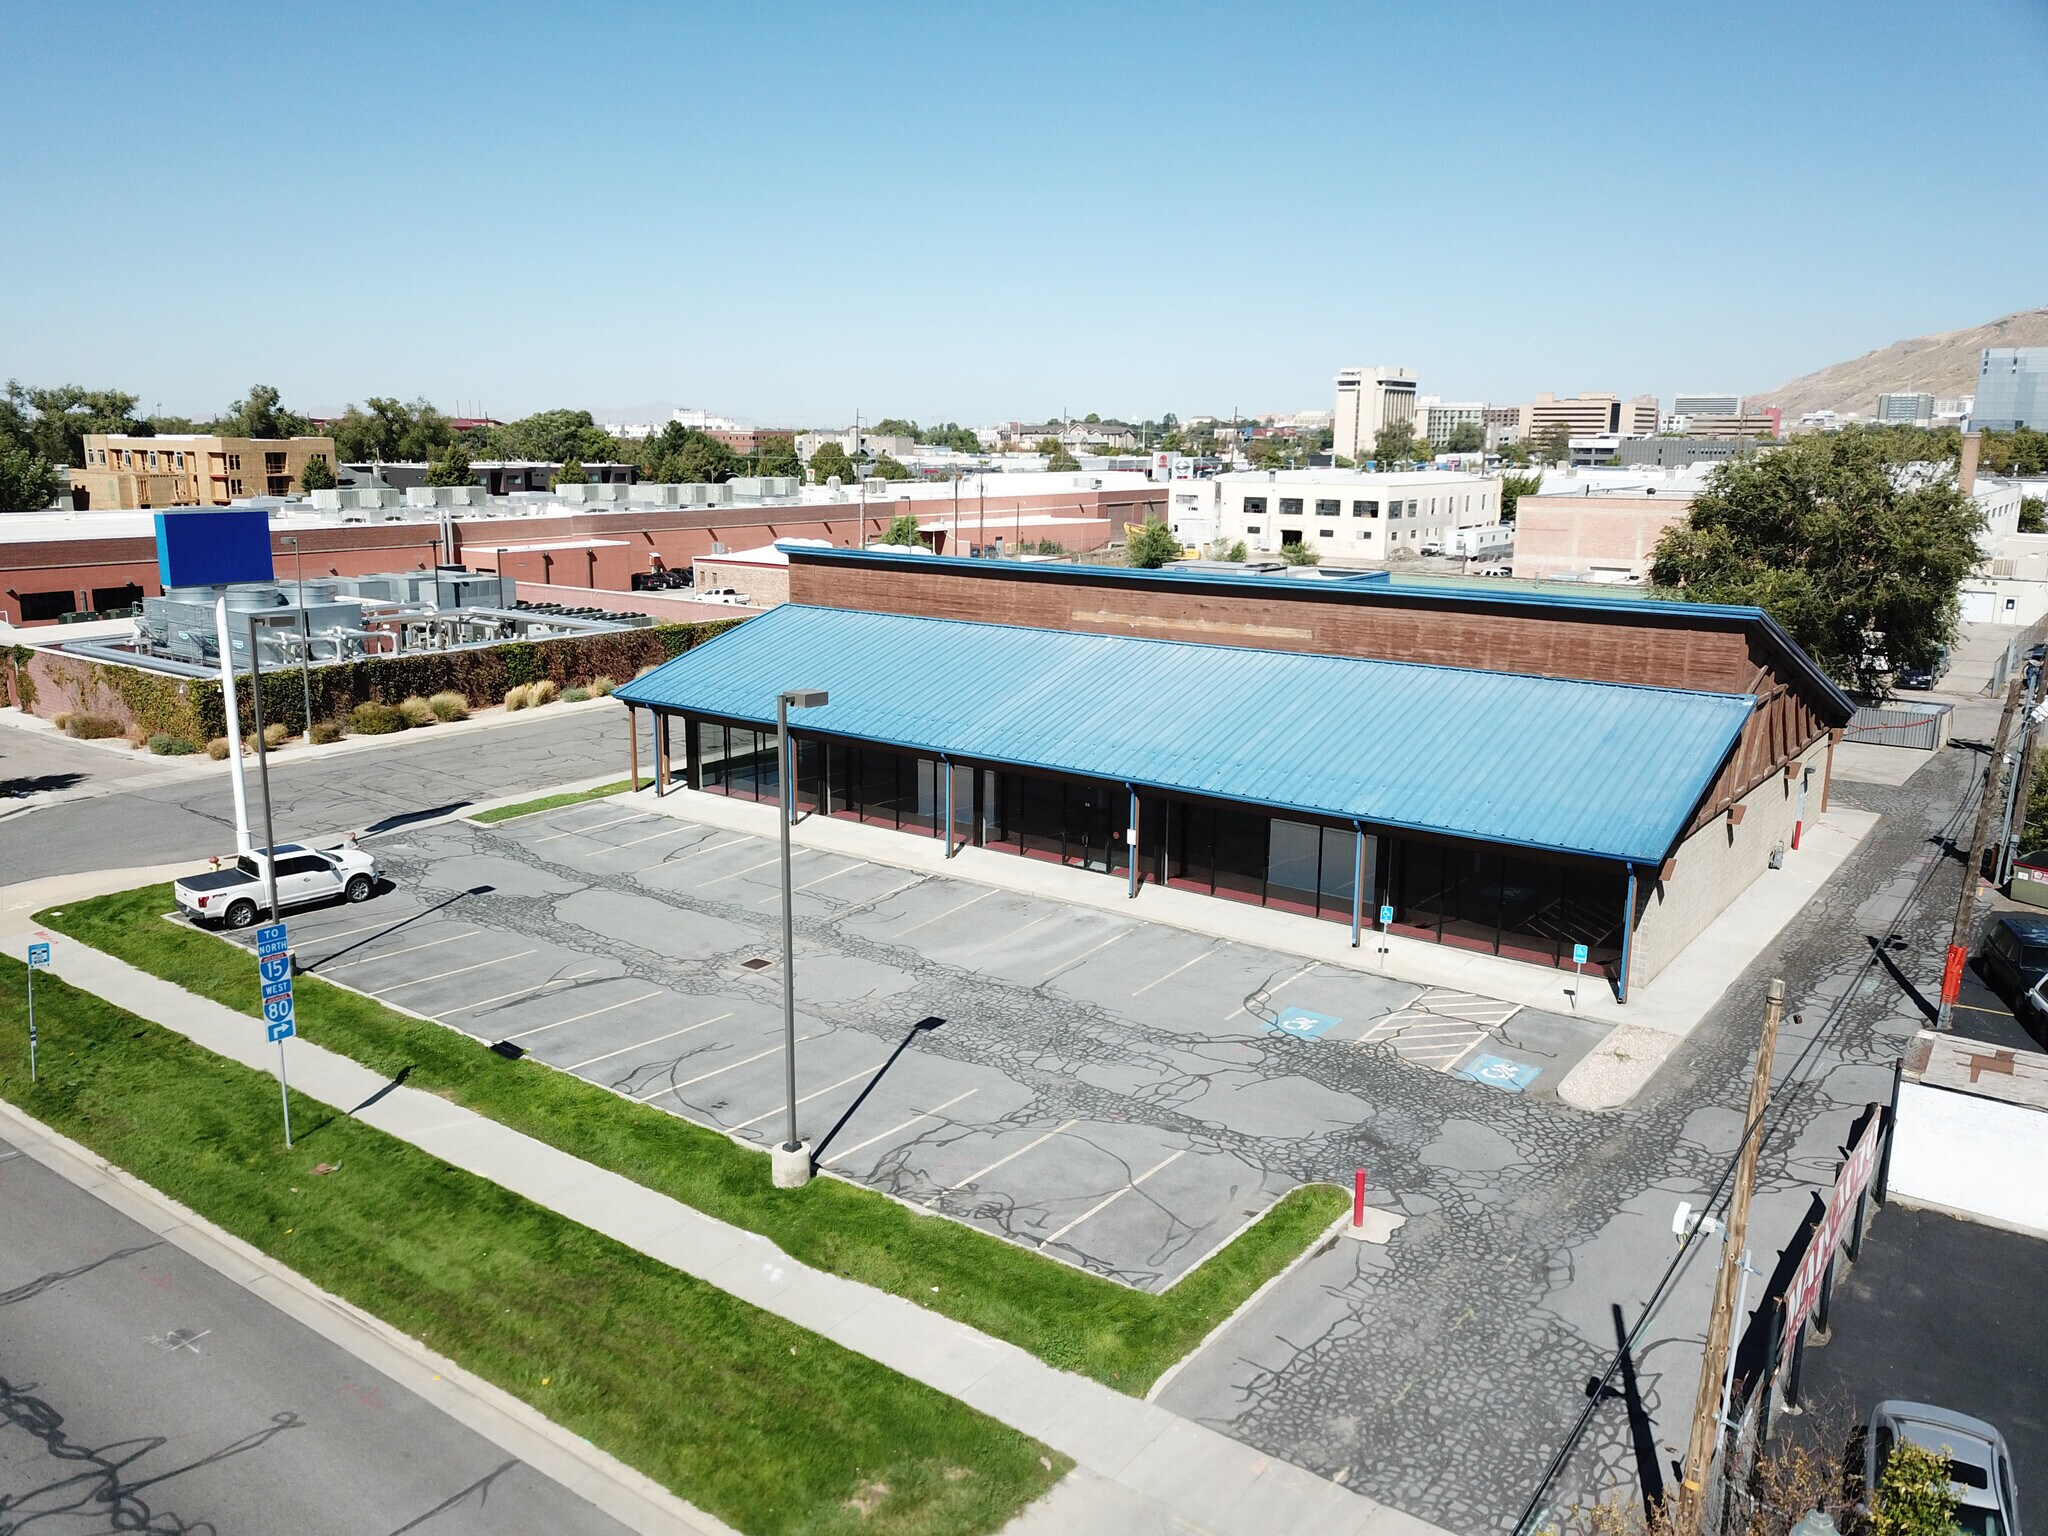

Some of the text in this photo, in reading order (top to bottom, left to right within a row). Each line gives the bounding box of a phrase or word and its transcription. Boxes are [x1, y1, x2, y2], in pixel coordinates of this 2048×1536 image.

[264, 929, 278, 939] TO
[259, 940, 287, 955] NORTH
[267, 960, 283, 978] 15
[265, 982, 287, 995] WEST
[269, 1000, 289, 1019] 80
